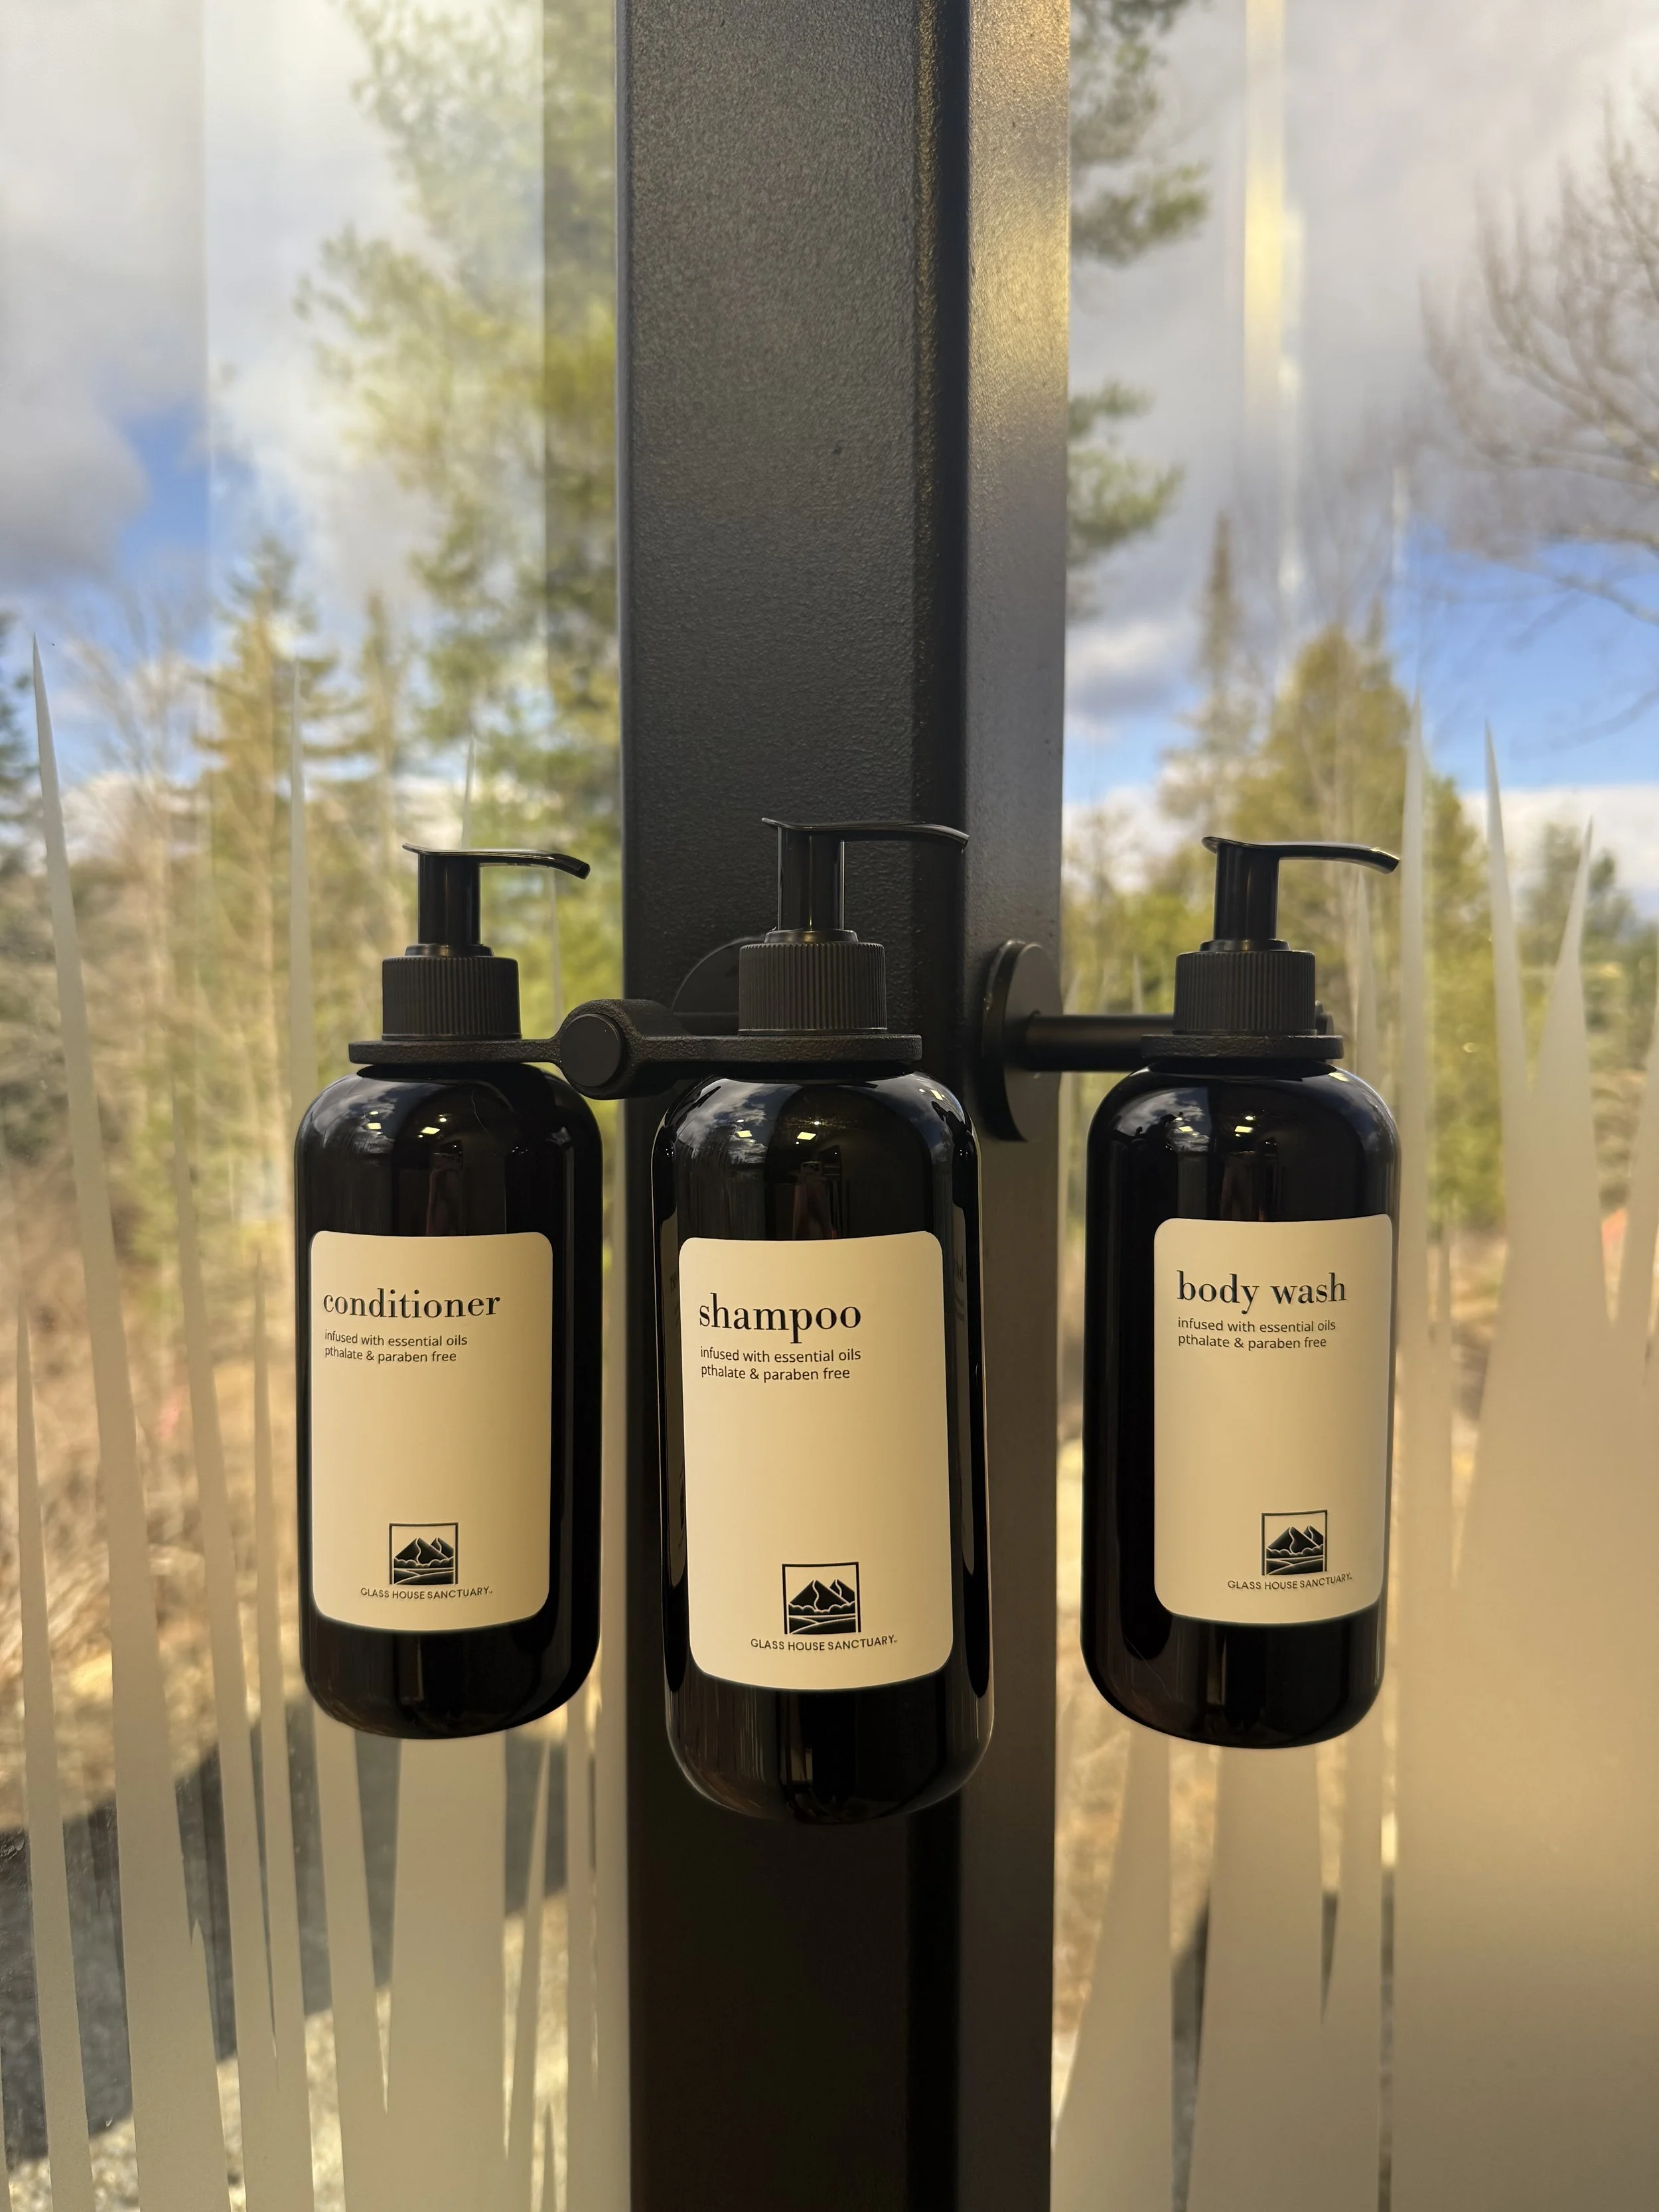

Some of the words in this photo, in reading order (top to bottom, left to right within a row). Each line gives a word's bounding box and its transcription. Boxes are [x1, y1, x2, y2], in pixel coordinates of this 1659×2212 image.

[1177, 1270, 1260, 1314] body
[1270, 1272, 1346, 1304] wash
[324, 1288, 500, 1318] conditioner
[699, 1293, 861, 1344] shampoo
[1179, 1317, 1223, 1331] infused
[1228, 1321, 1255, 1332] with
[1260, 1321, 1313, 1332] essential
[1318, 1319, 1335, 1331] oils
[325, 1329, 358, 1343] infused
[361, 1335, 384, 1345] with
[388, 1335, 442, 1346] essential
[447, 1335, 467, 1345] oils
[1179, 1335, 1230, 1347] pthalate
[1234, 1338, 1244, 1348] &
[1249, 1338, 1300, 1351] paraben
[1304, 1337, 1326, 1347] free
[325, 1345, 363, 1360] pthalate
[366, 1351, 374, 1361] &
[378, 1352, 427, 1364] paraben
[431, 1351, 456, 1361] free
[701, 1346, 739, 1361] infused
[743, 1351, 770, 1362] with
[774, 1350, 833, 1363] essential
[839, 1349, 861, 1361] oils
[701, 1364, 745, 1378] pthalate
[750, 1368, 759, 1379] &
[764, 1368, 818, 1383] paraben
[823, 1368, 849, 1379] free
[361, 1587, 390, 1597] GLASS
[393, 1590, 425, 1599] HOUSE
[1228, 1581, 1261, 1589] GLASS
[1265, 1581, 1297, 1589] HOUSE
[751, 1639, 784, 1649] GLASS
[788, 1642, 825, 1651] HOUSE
